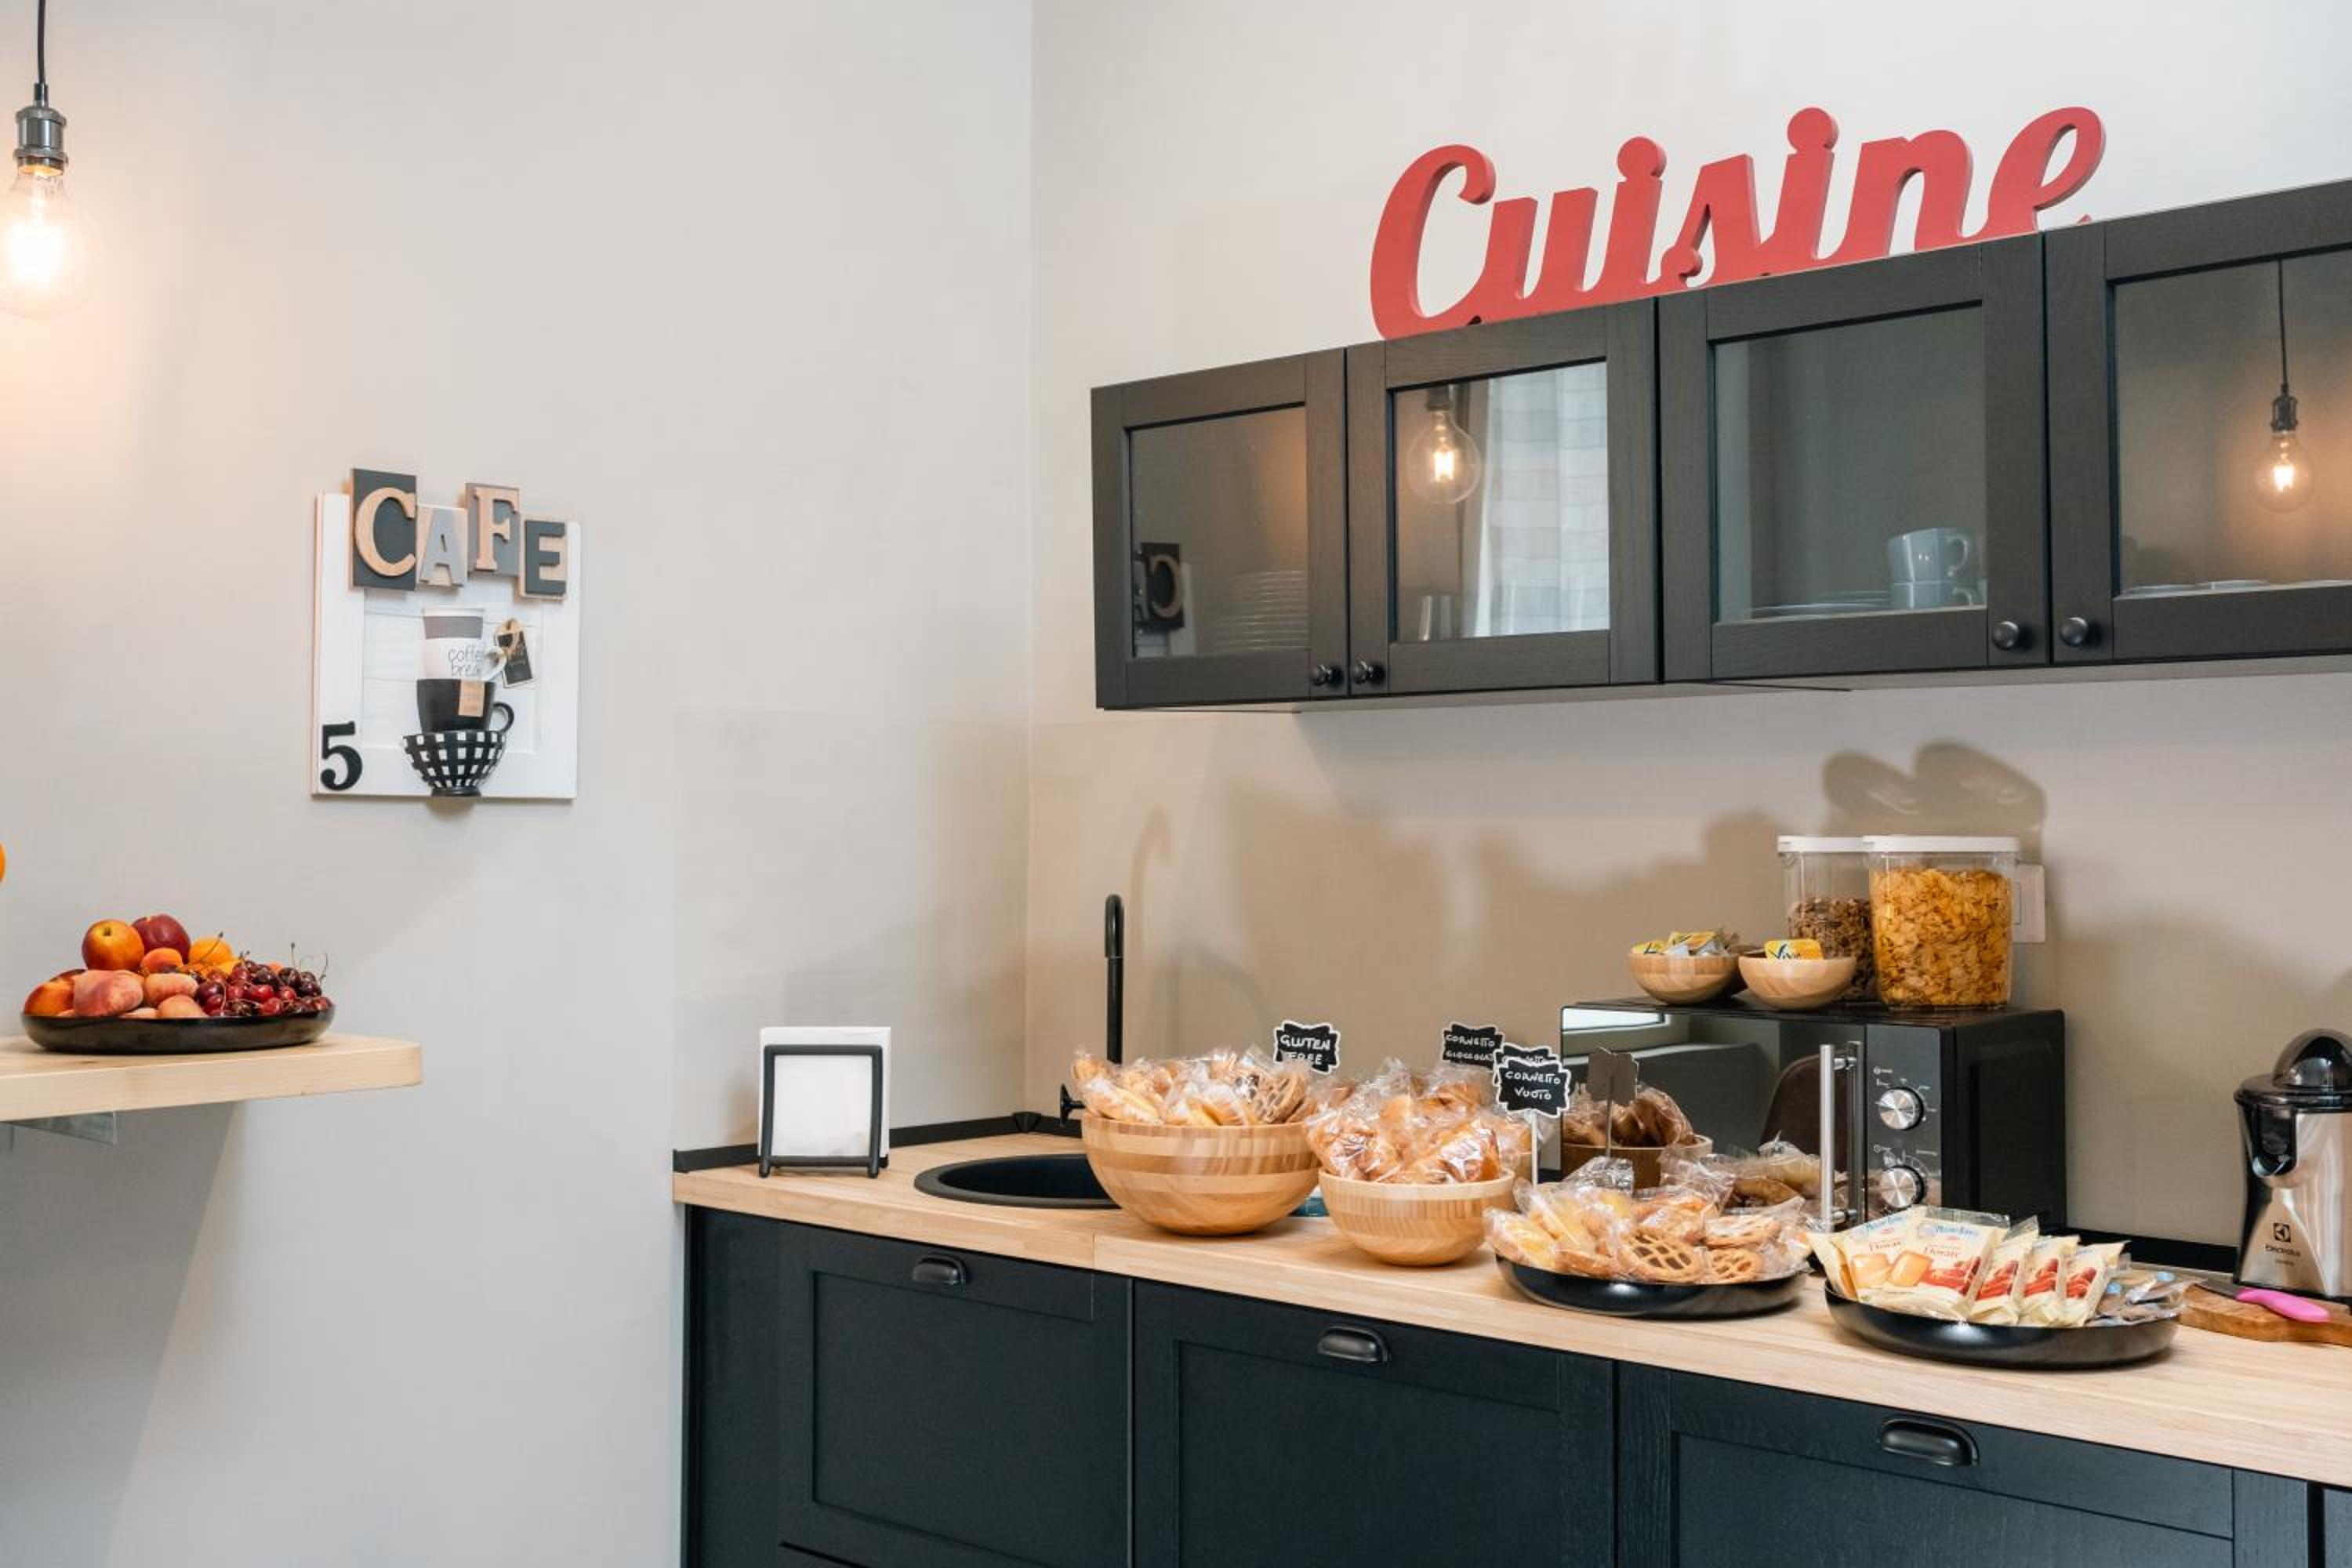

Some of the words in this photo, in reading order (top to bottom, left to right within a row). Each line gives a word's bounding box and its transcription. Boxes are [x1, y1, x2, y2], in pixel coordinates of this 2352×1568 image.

[1369, 105, 2107, 341] Cuisine
[354, 486, 566, 596] CAFE
[320, 720, 363, 791] 5
[1280, 1034, 1330, 1051] GLUTEN
[1446, 1034, 1496, 1048] CORNETTO
[1504, 1071, 1561, 1084] CORNETTO
[1514, 1087, 1552, 1100] VUOTO
